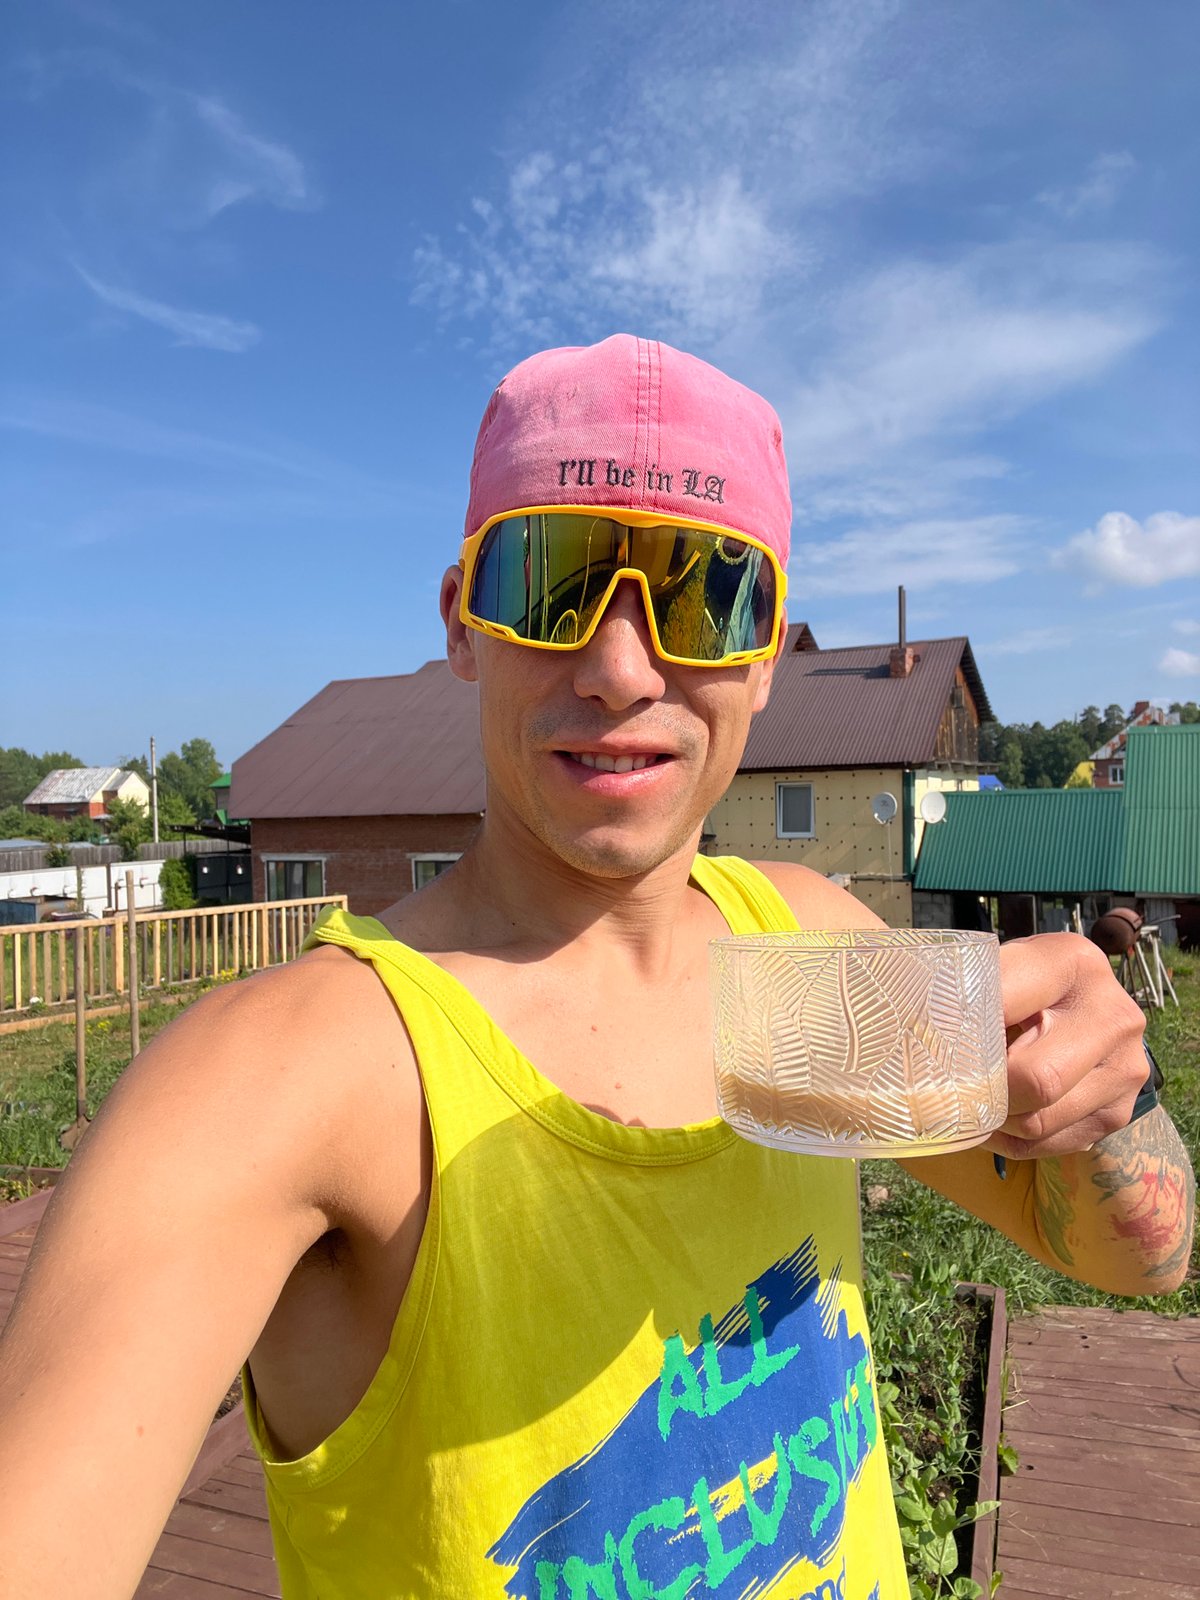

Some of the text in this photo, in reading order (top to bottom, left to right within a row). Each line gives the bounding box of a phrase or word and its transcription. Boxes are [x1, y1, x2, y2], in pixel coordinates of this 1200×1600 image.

[606, 458, 636, 488] be
[647, 463, 674, 493] in
[682, 467, 726, 504] LA
[658, 1286, 800, 1442] ALL
